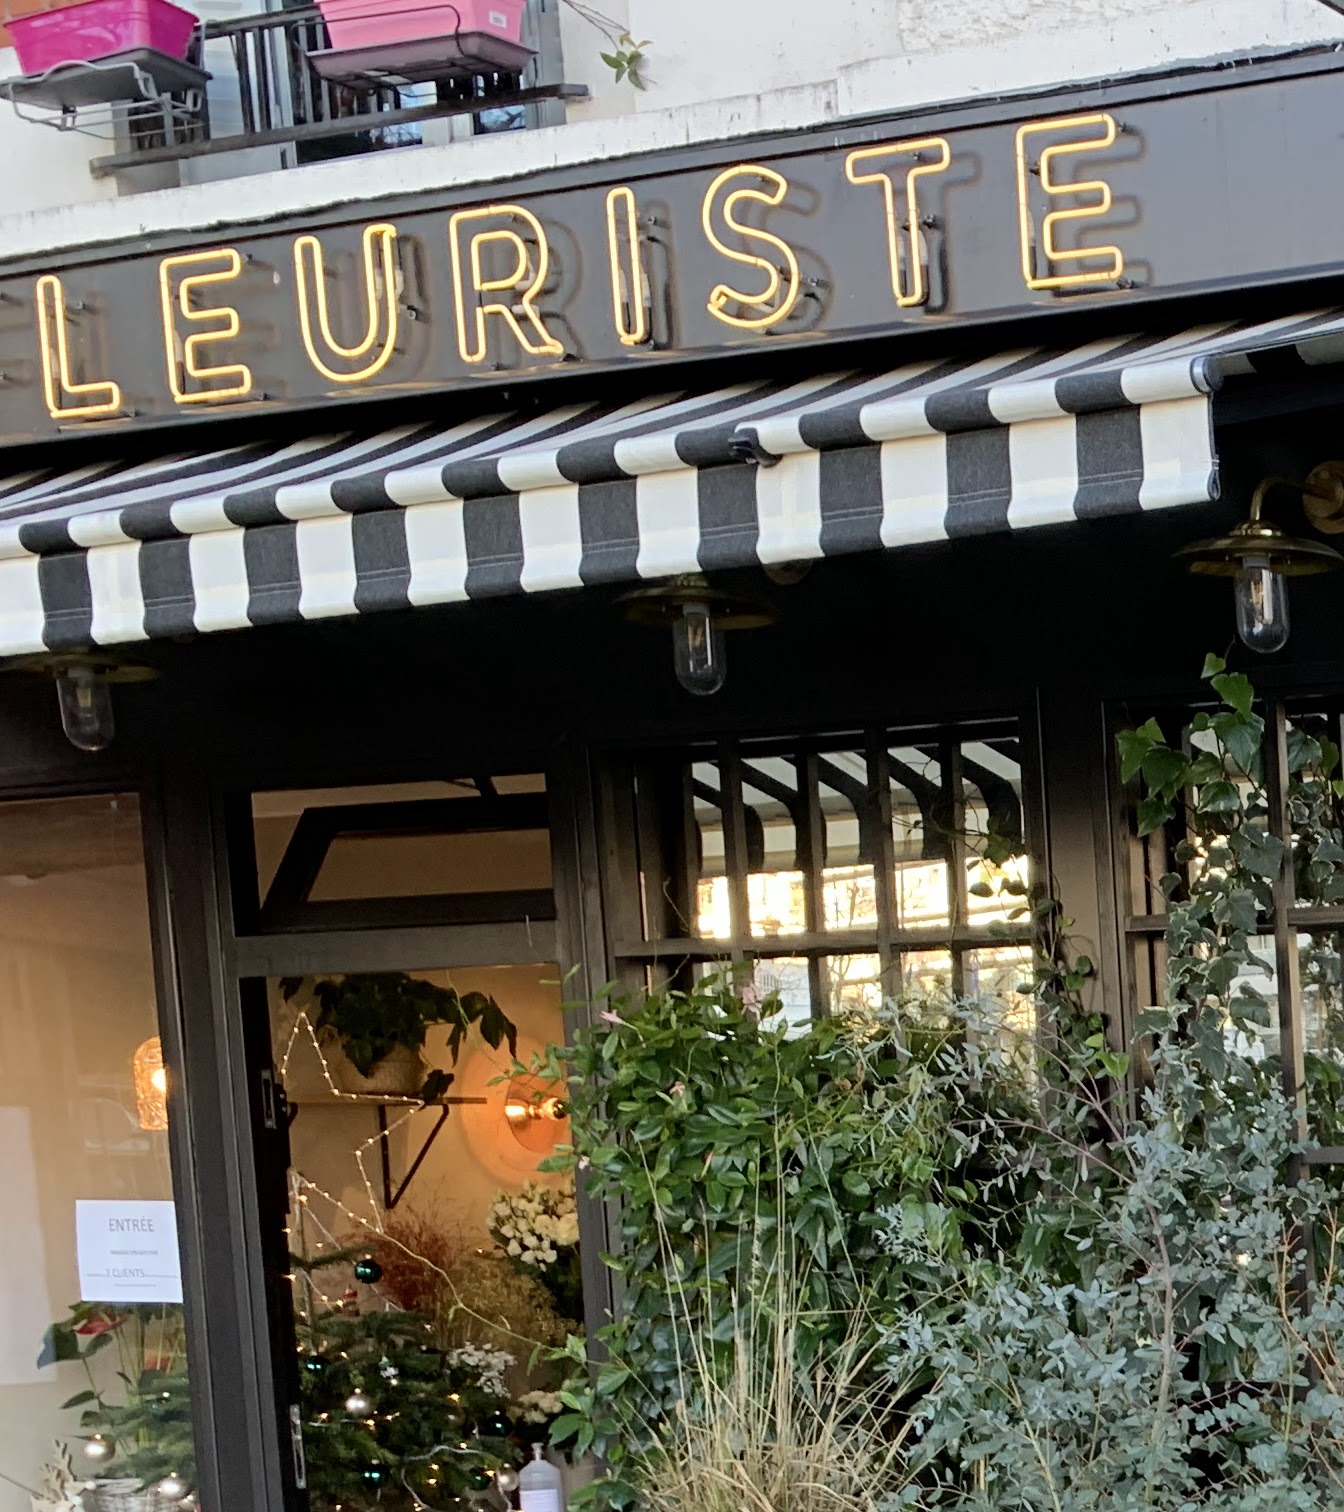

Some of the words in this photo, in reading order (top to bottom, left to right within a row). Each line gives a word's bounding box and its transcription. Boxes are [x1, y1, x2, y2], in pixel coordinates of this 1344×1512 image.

[36, 113, 1125, 418] LEURISTE
[108, 1216, 155, 1232] ENTRÉE
[112, 1268, 145, 1278] CLIENTS
